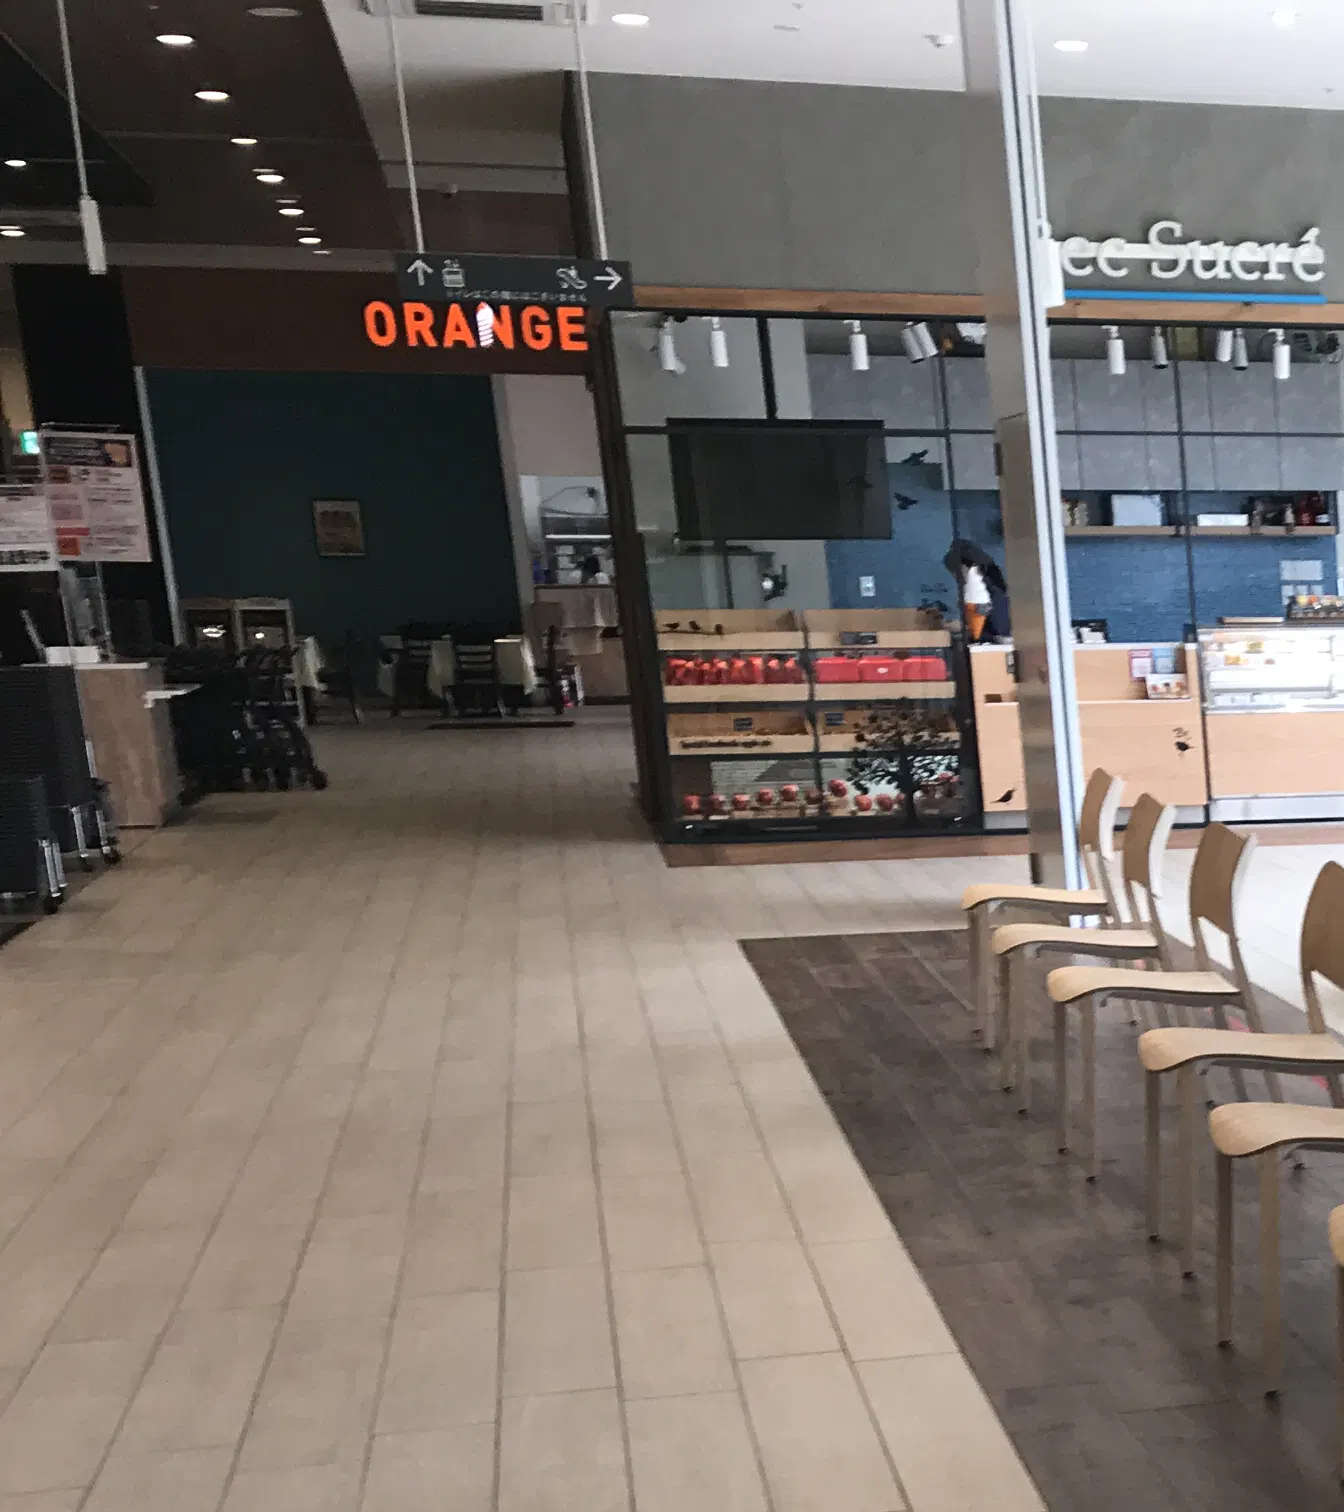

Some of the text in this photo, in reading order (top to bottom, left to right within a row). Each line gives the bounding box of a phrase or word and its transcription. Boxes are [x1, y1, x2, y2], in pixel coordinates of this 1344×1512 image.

[1058, 220, 1327, 283] ec Sucré
[363, 300, 589, 352] ORANGE
